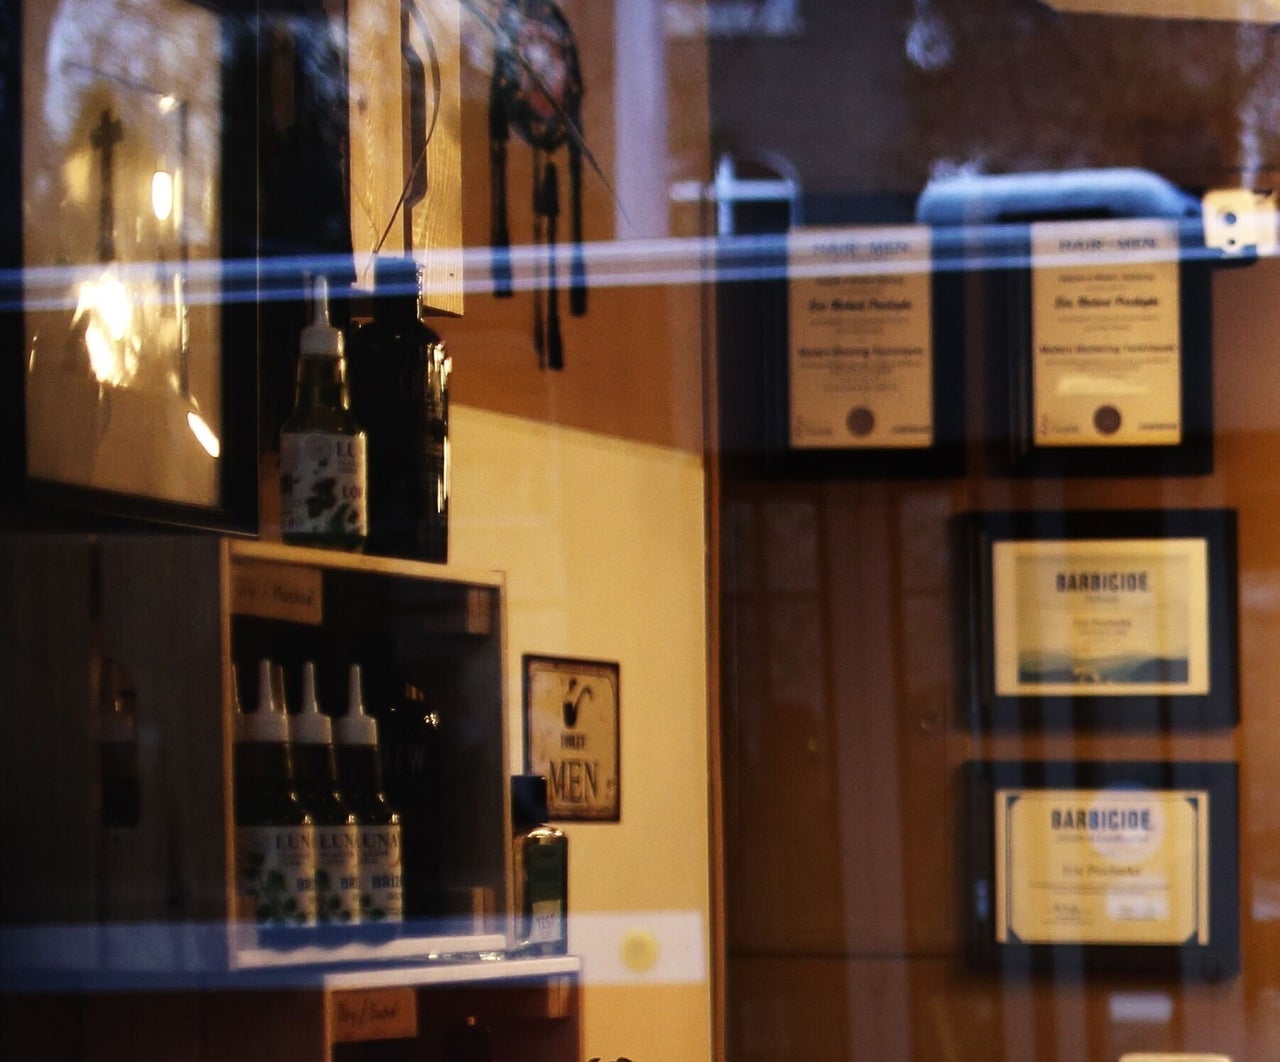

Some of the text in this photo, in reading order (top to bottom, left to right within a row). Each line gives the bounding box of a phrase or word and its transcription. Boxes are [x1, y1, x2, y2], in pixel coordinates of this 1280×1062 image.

[1056, 571, 1147, 592] BARBICIDE
[550, 759, 600, 803] MEN
[1051, 809, 1150, 830] BARBICIDE
